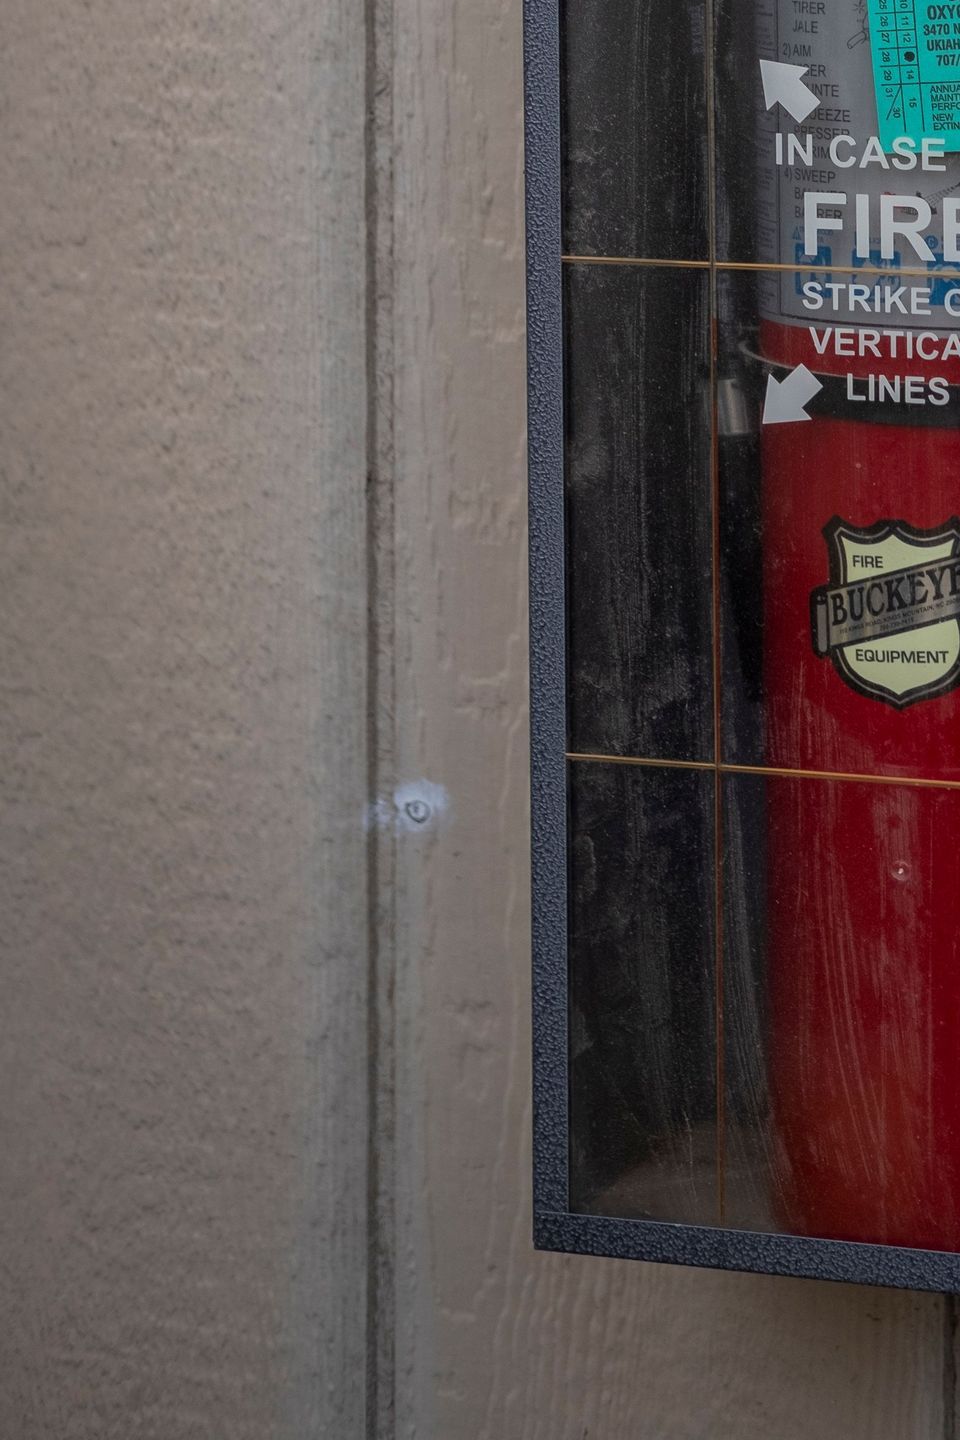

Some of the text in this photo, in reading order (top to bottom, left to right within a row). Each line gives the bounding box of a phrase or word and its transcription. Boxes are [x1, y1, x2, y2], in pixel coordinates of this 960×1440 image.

[792, 0, 826, 14] TIRER
[878, 0, 887, 10] 25
[792, 20, 819, 34] JALE
[903, 16, 909, 26] 11
[923, 22, 950, 36] 3470
[881, 33, 889, 43] 27
[903, 32, 911, 43] 12
[782, 42, 812, 57] 2) AIM
[882, 51, 890, 62] 28
[884, 70, 892, 81] 29
[906, 70, 914, 80] 14
[886, 88, 893, 98] 31
[909, 98, 916, 108] 15
[893, 109, 900, 118] 30
[933, 114, 954, 122] NEW
[775, 132, 813, 167] IN
[829, 135, 946, 173] CASE
[784, 168, 836, 184] 4) SWEEP
[802, 282, 932, 316] STRIKE
[846, 373, 950, 406] LINES
[852, 554, 884, 569] FIRE
[902, 605, 935, 618] MOUNTAIN,
[855, 648, 949, 664] EQUIPMENT
